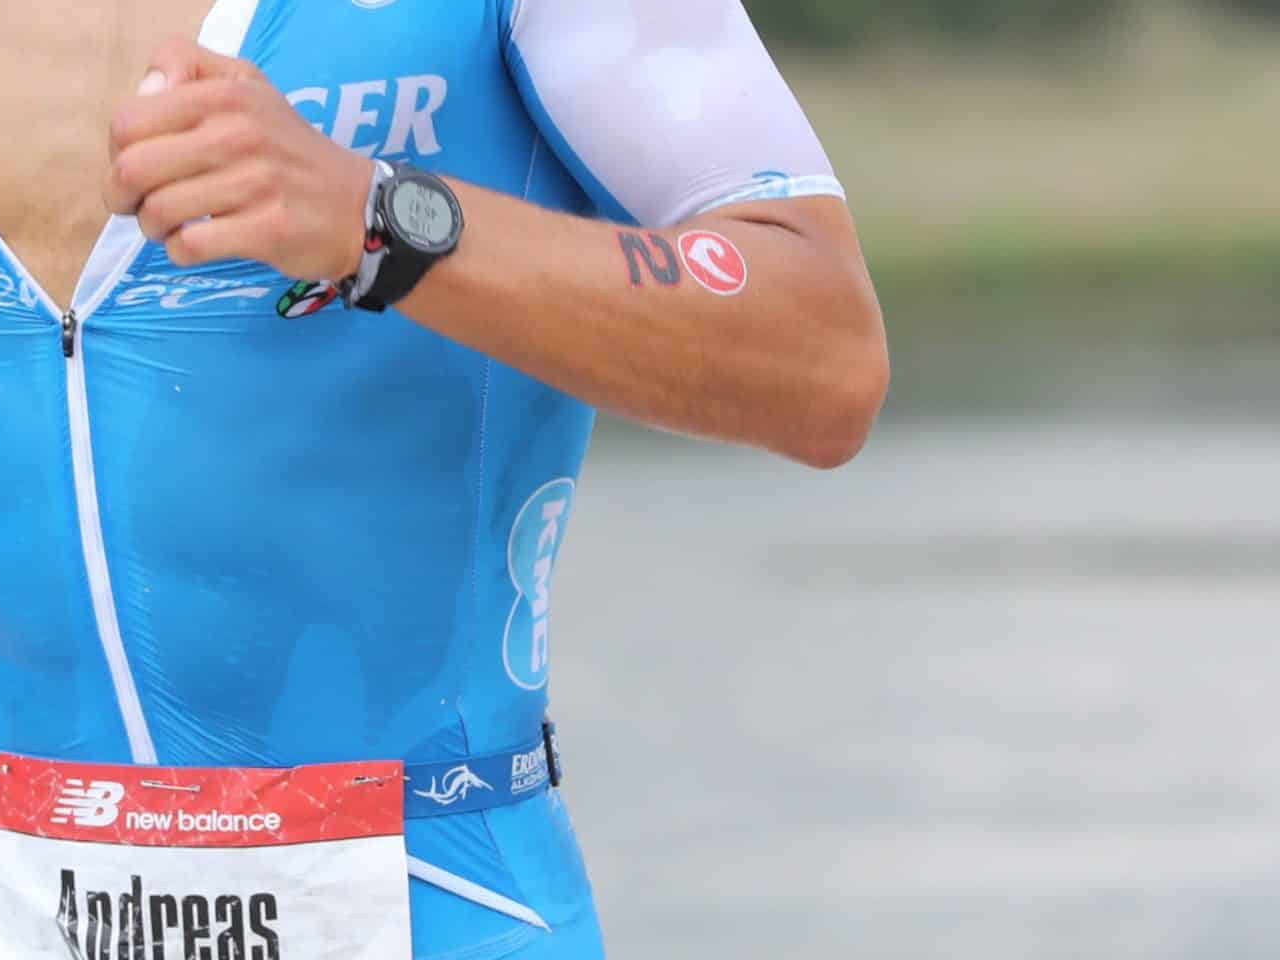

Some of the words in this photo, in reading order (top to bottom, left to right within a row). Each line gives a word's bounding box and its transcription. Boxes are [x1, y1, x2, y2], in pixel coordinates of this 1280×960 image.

[126, 811, 172, 830] new
[178, 809, 282, 832] balance
[56, 868, 281, 960] Andreas
